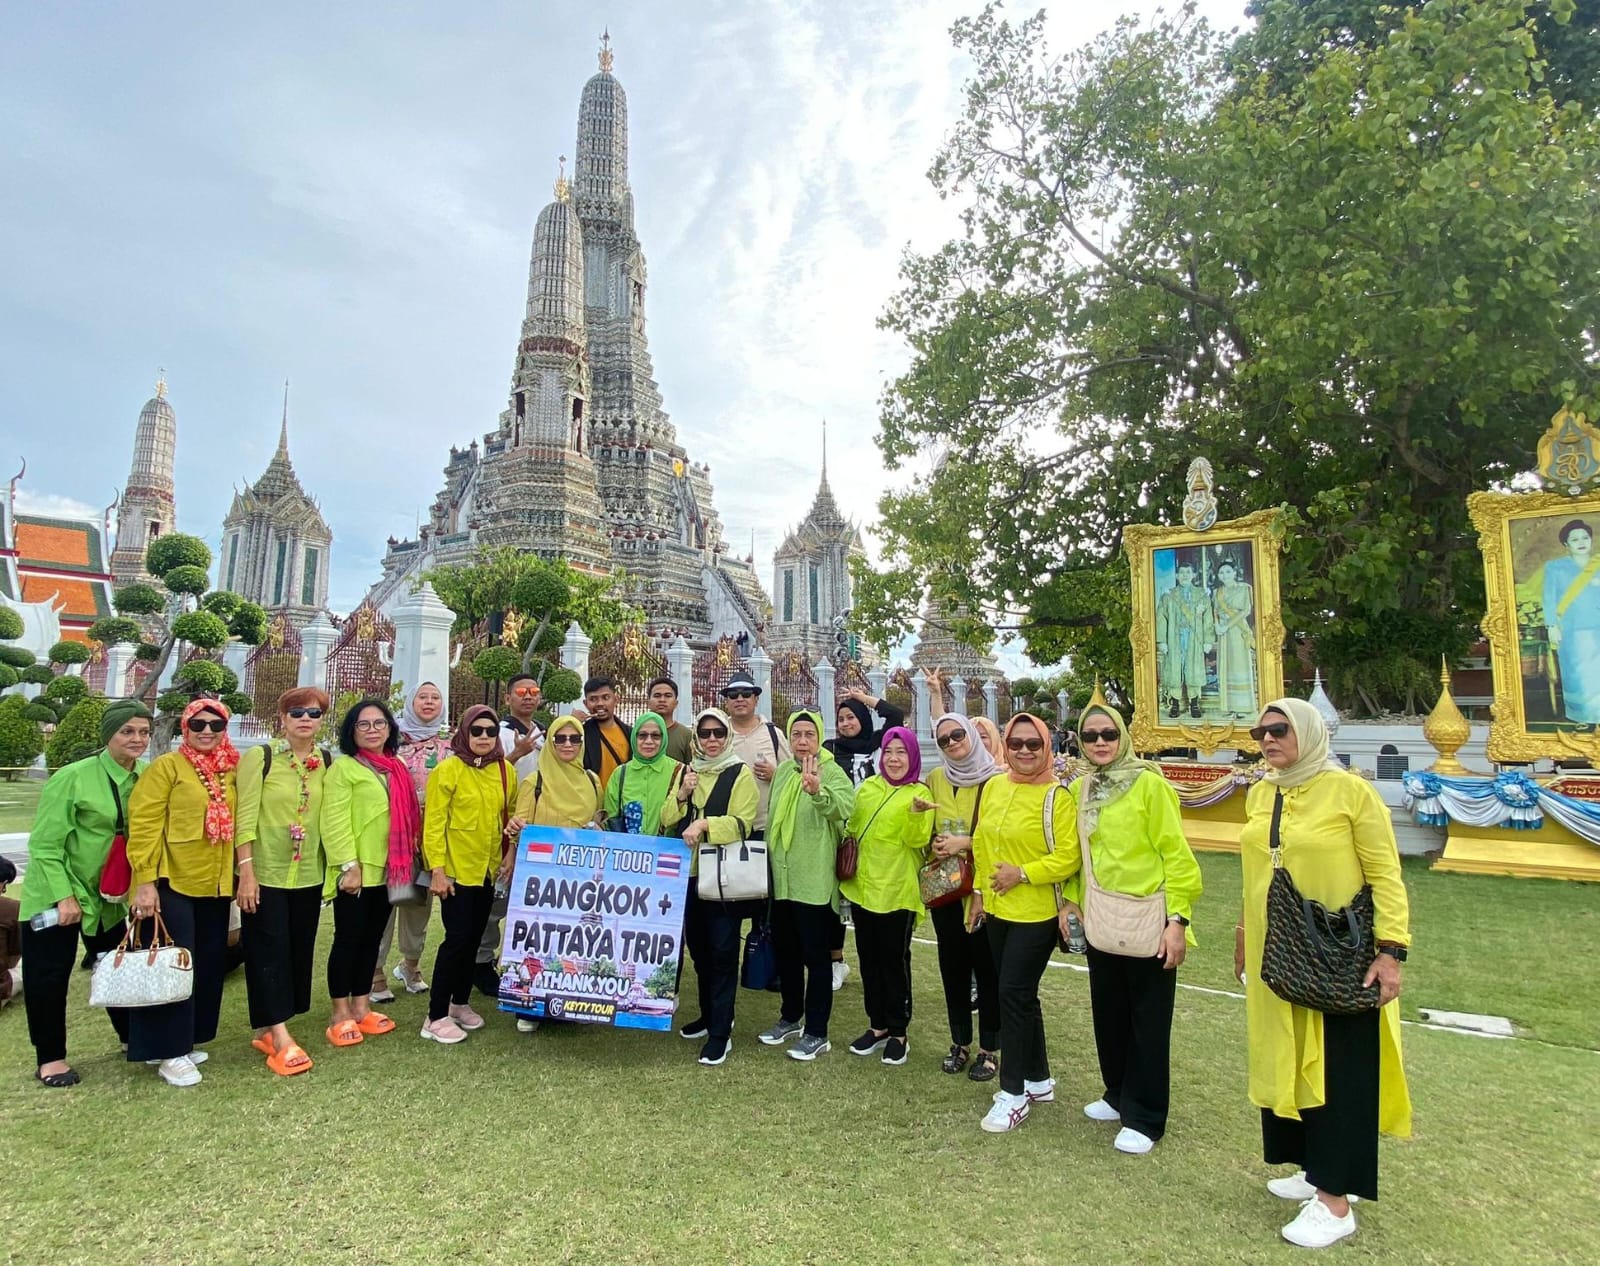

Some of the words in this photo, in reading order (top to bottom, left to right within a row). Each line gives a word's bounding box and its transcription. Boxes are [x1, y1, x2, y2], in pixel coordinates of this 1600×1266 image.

[1565, 784, 1600, 795] ทรง
[557, 844, 608, 869] KEYTY
[613, 849, 653, 874] TOUR
[524, 876, 651, 917] BANGKOK
[658, 893, 672, 916] +
[511, 920, 614, 960] PATTAYA
[621, 931, 675, 965] TRIP
[542, 971, 596, 993] THANK
[596, 975, 631, 997] YOU
[563, 1000, 591, 1013] KEYTY
[591, 1003, 615, 1016] TOUR
